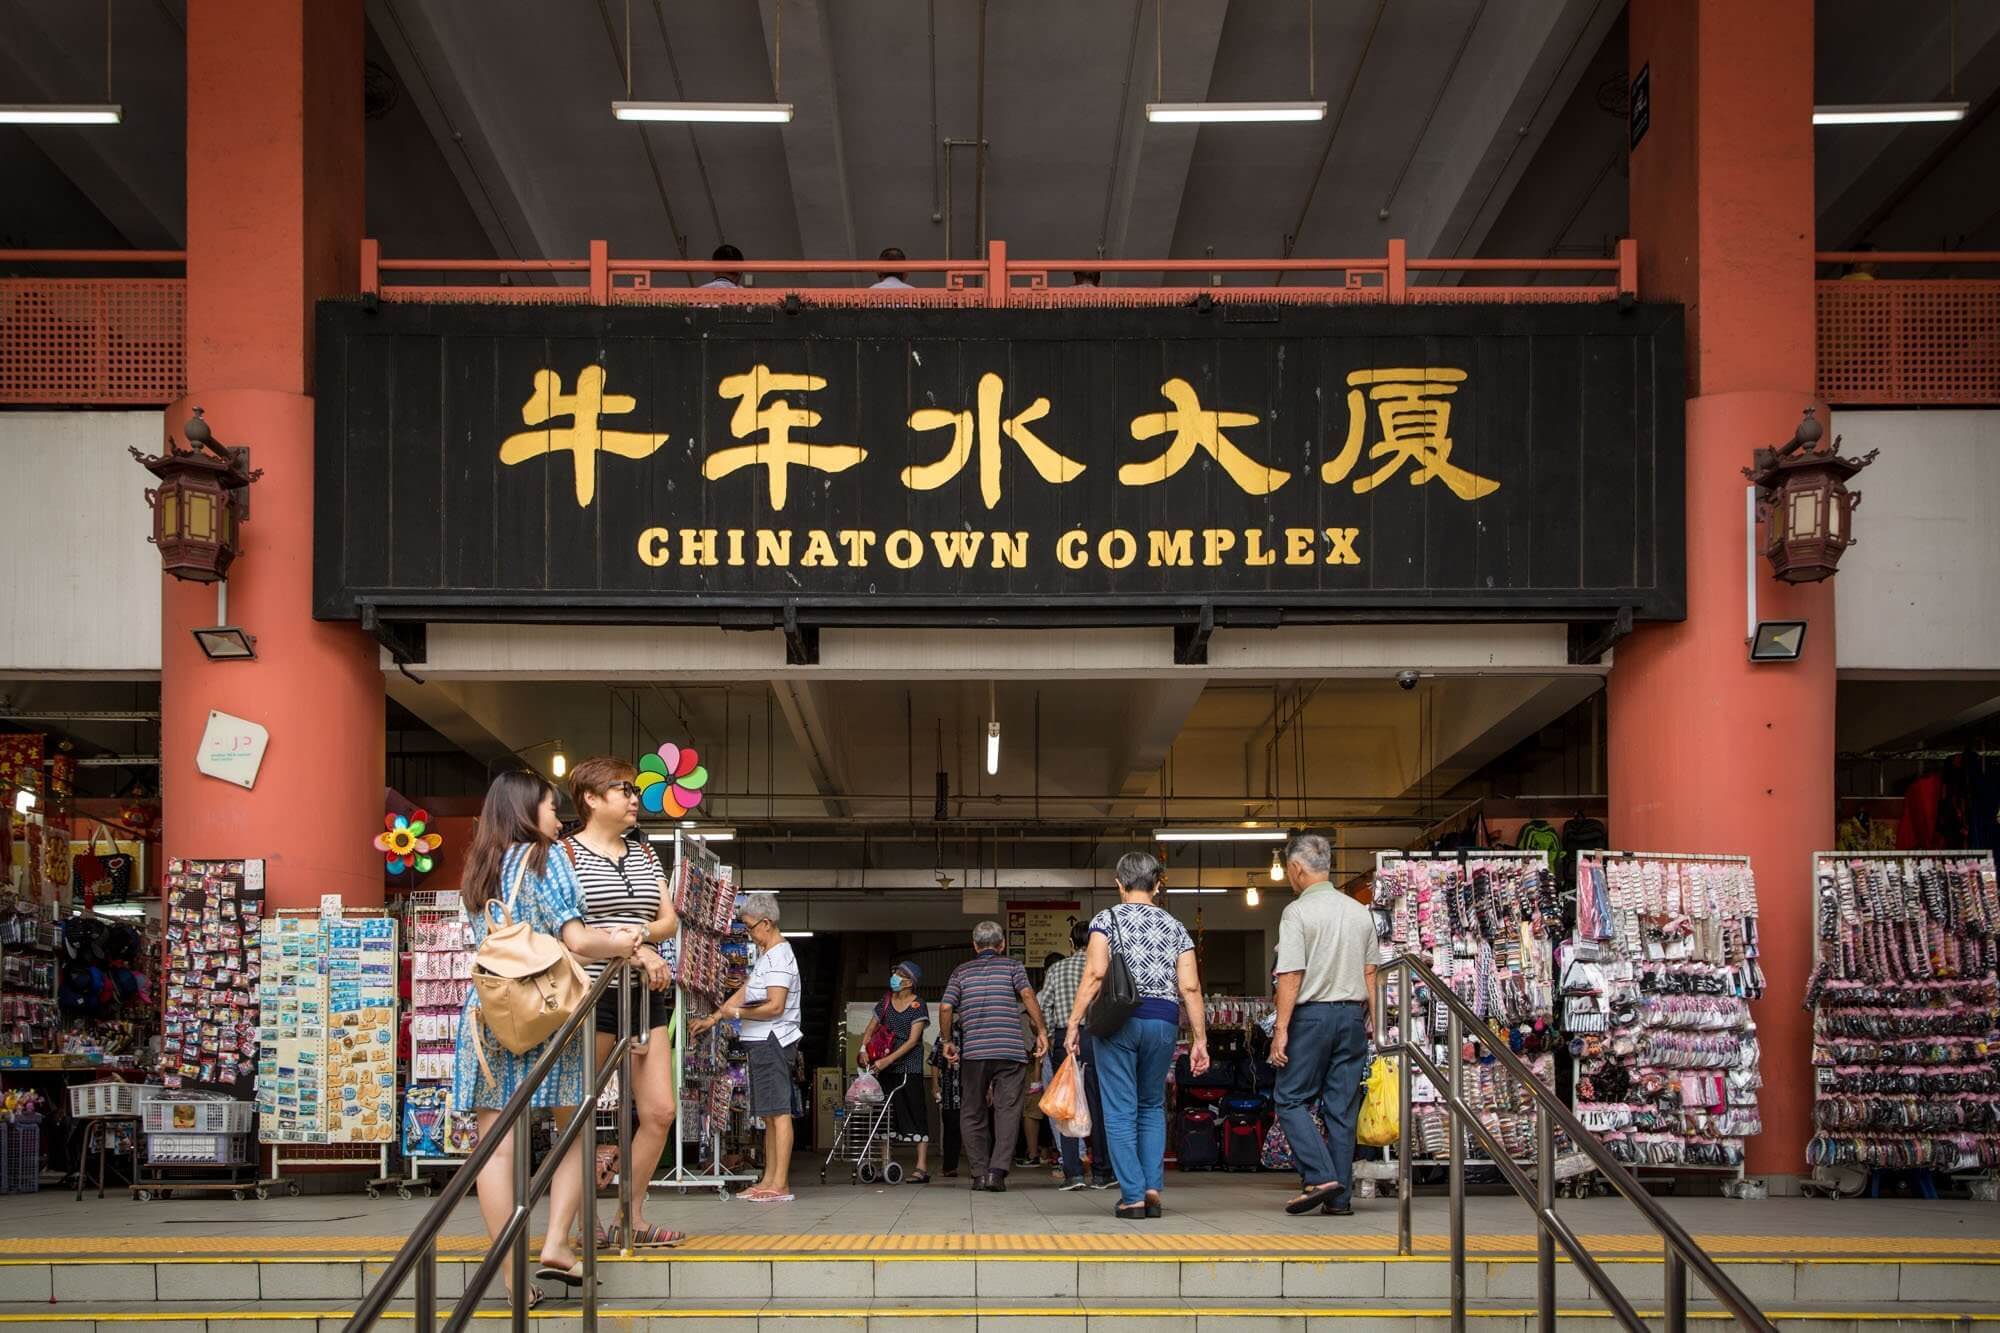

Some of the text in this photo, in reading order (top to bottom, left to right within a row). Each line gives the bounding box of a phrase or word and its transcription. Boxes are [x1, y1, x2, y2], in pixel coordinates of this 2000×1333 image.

[499, 364, 1500, 510] 牛车水大厦
[637, 527, 1361, 570] CHINATOWN COMPLEX
